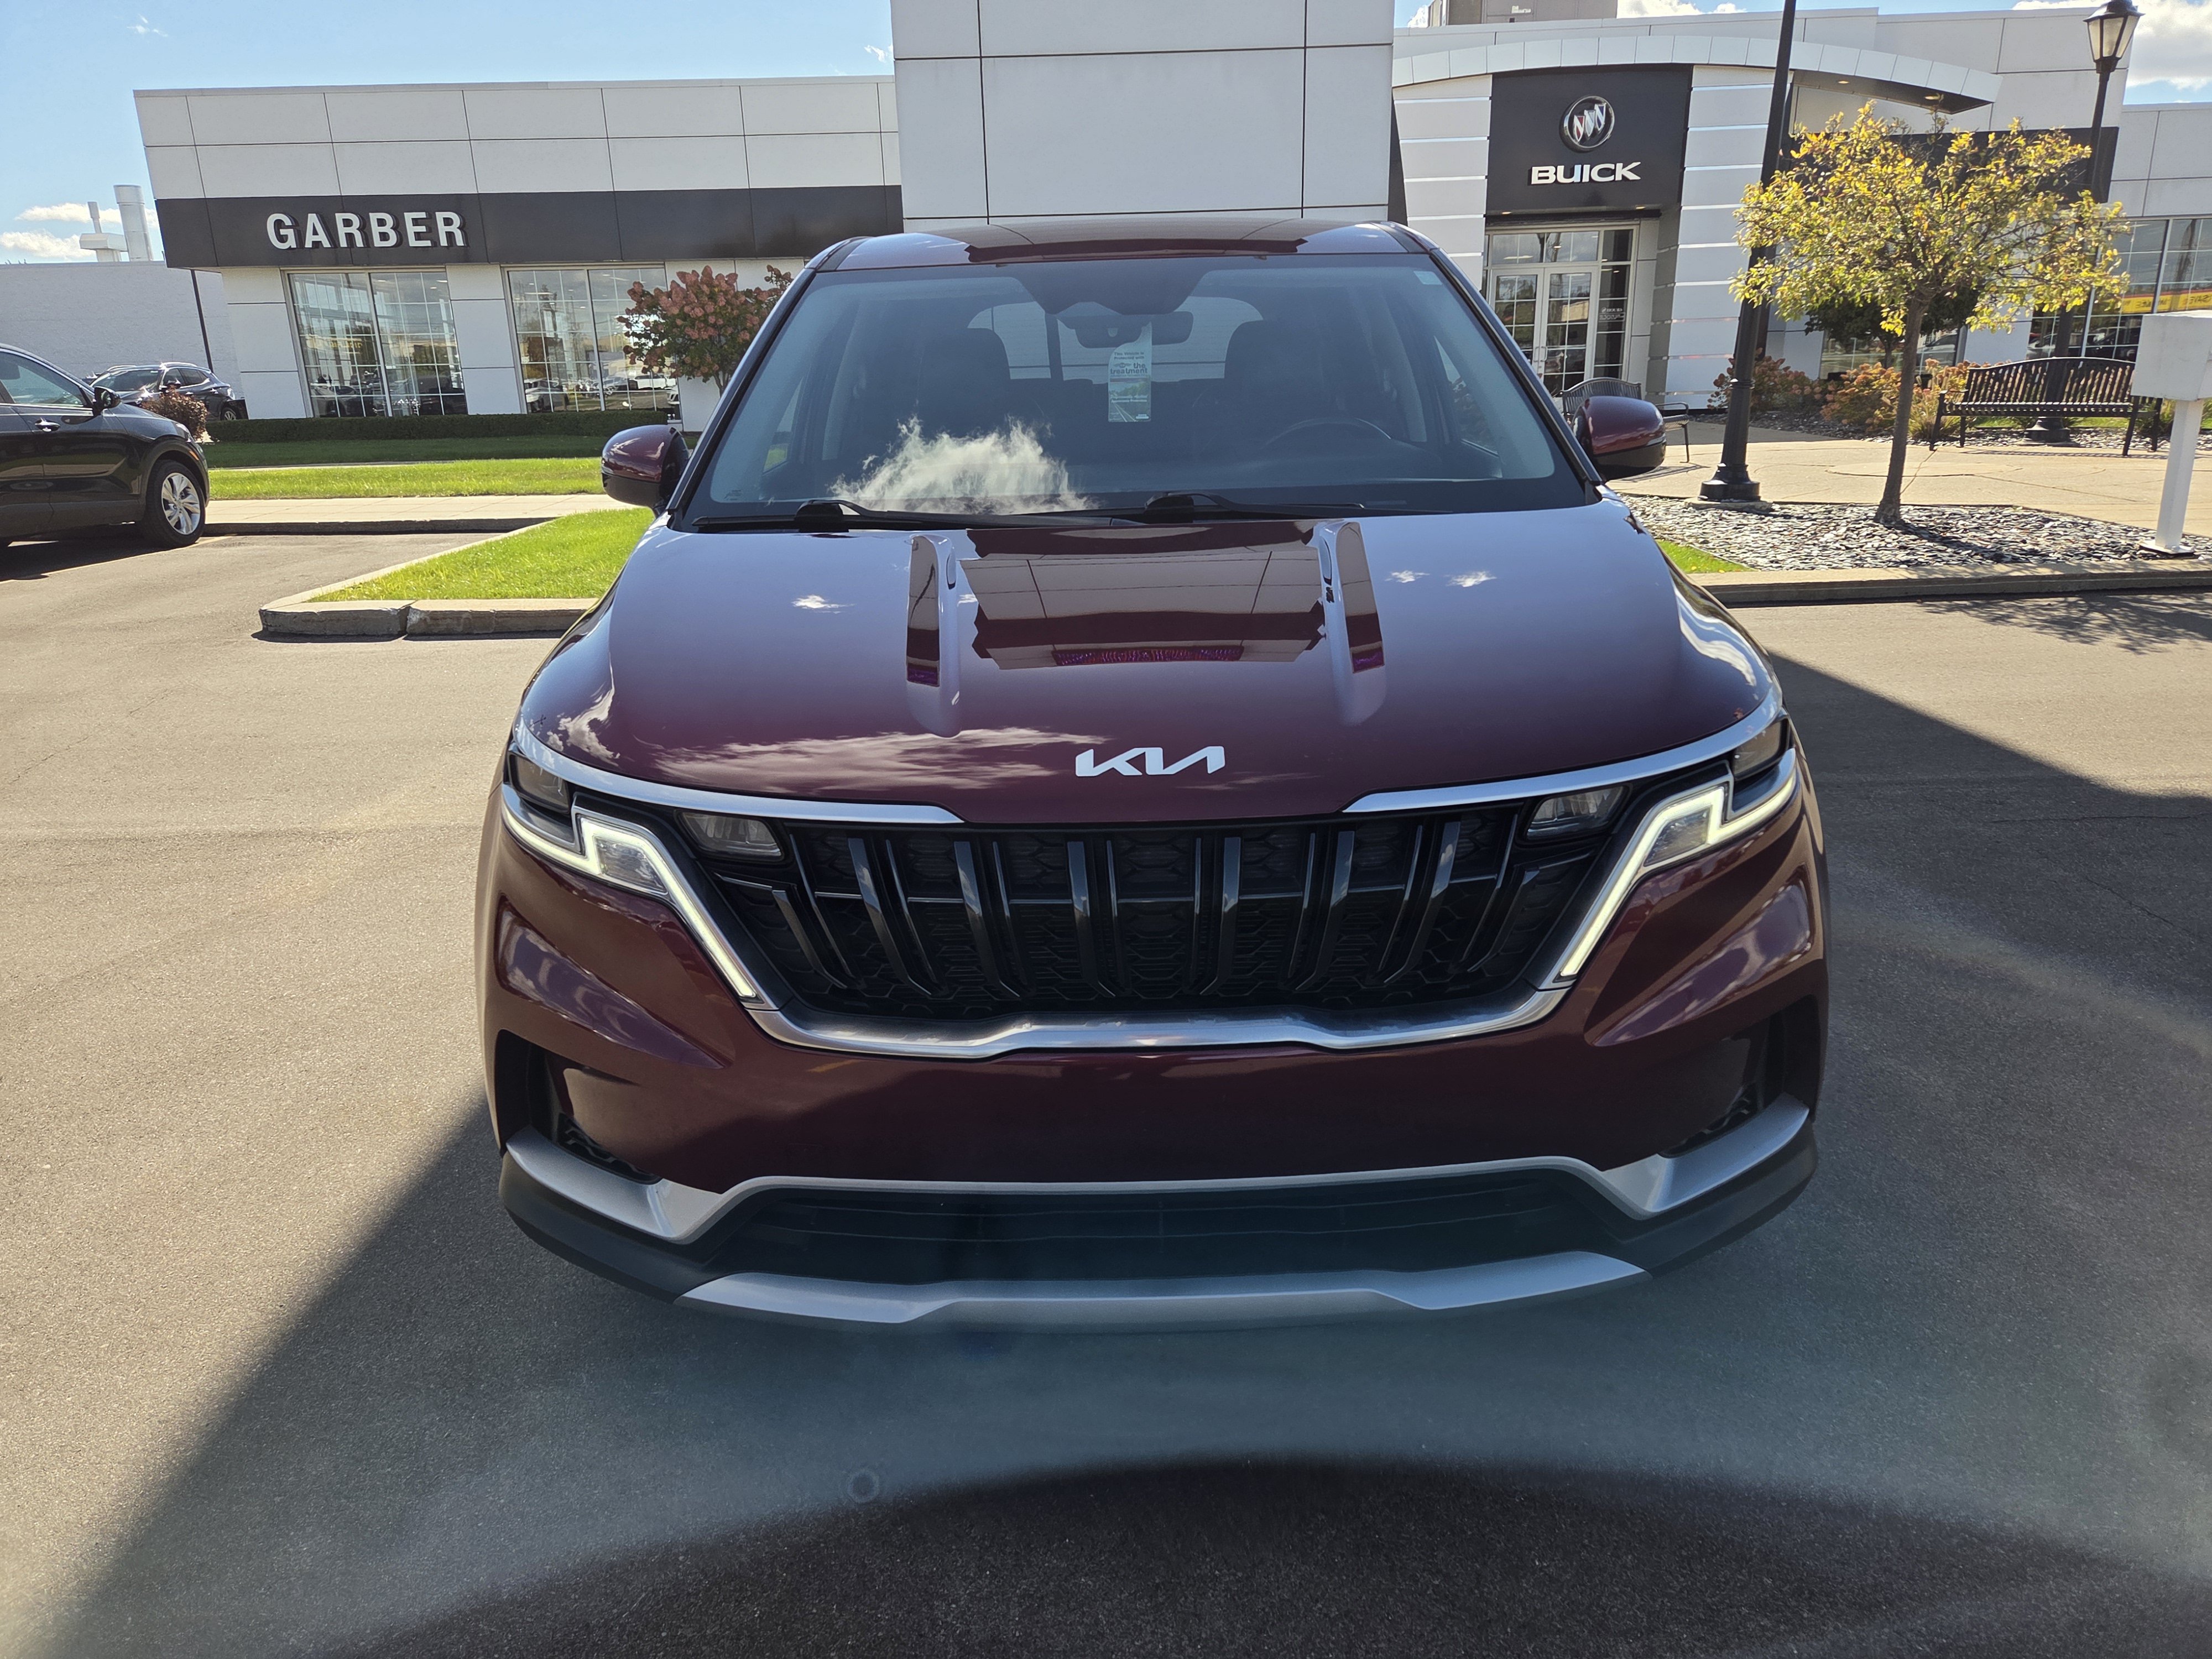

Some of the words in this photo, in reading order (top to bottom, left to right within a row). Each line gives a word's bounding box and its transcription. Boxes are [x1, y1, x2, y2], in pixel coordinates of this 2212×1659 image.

[1531, 161, 1641, 185] BUICK
[267, 212, 465, 249] GARBER
[1076, 745, 1225, 777] KIA
